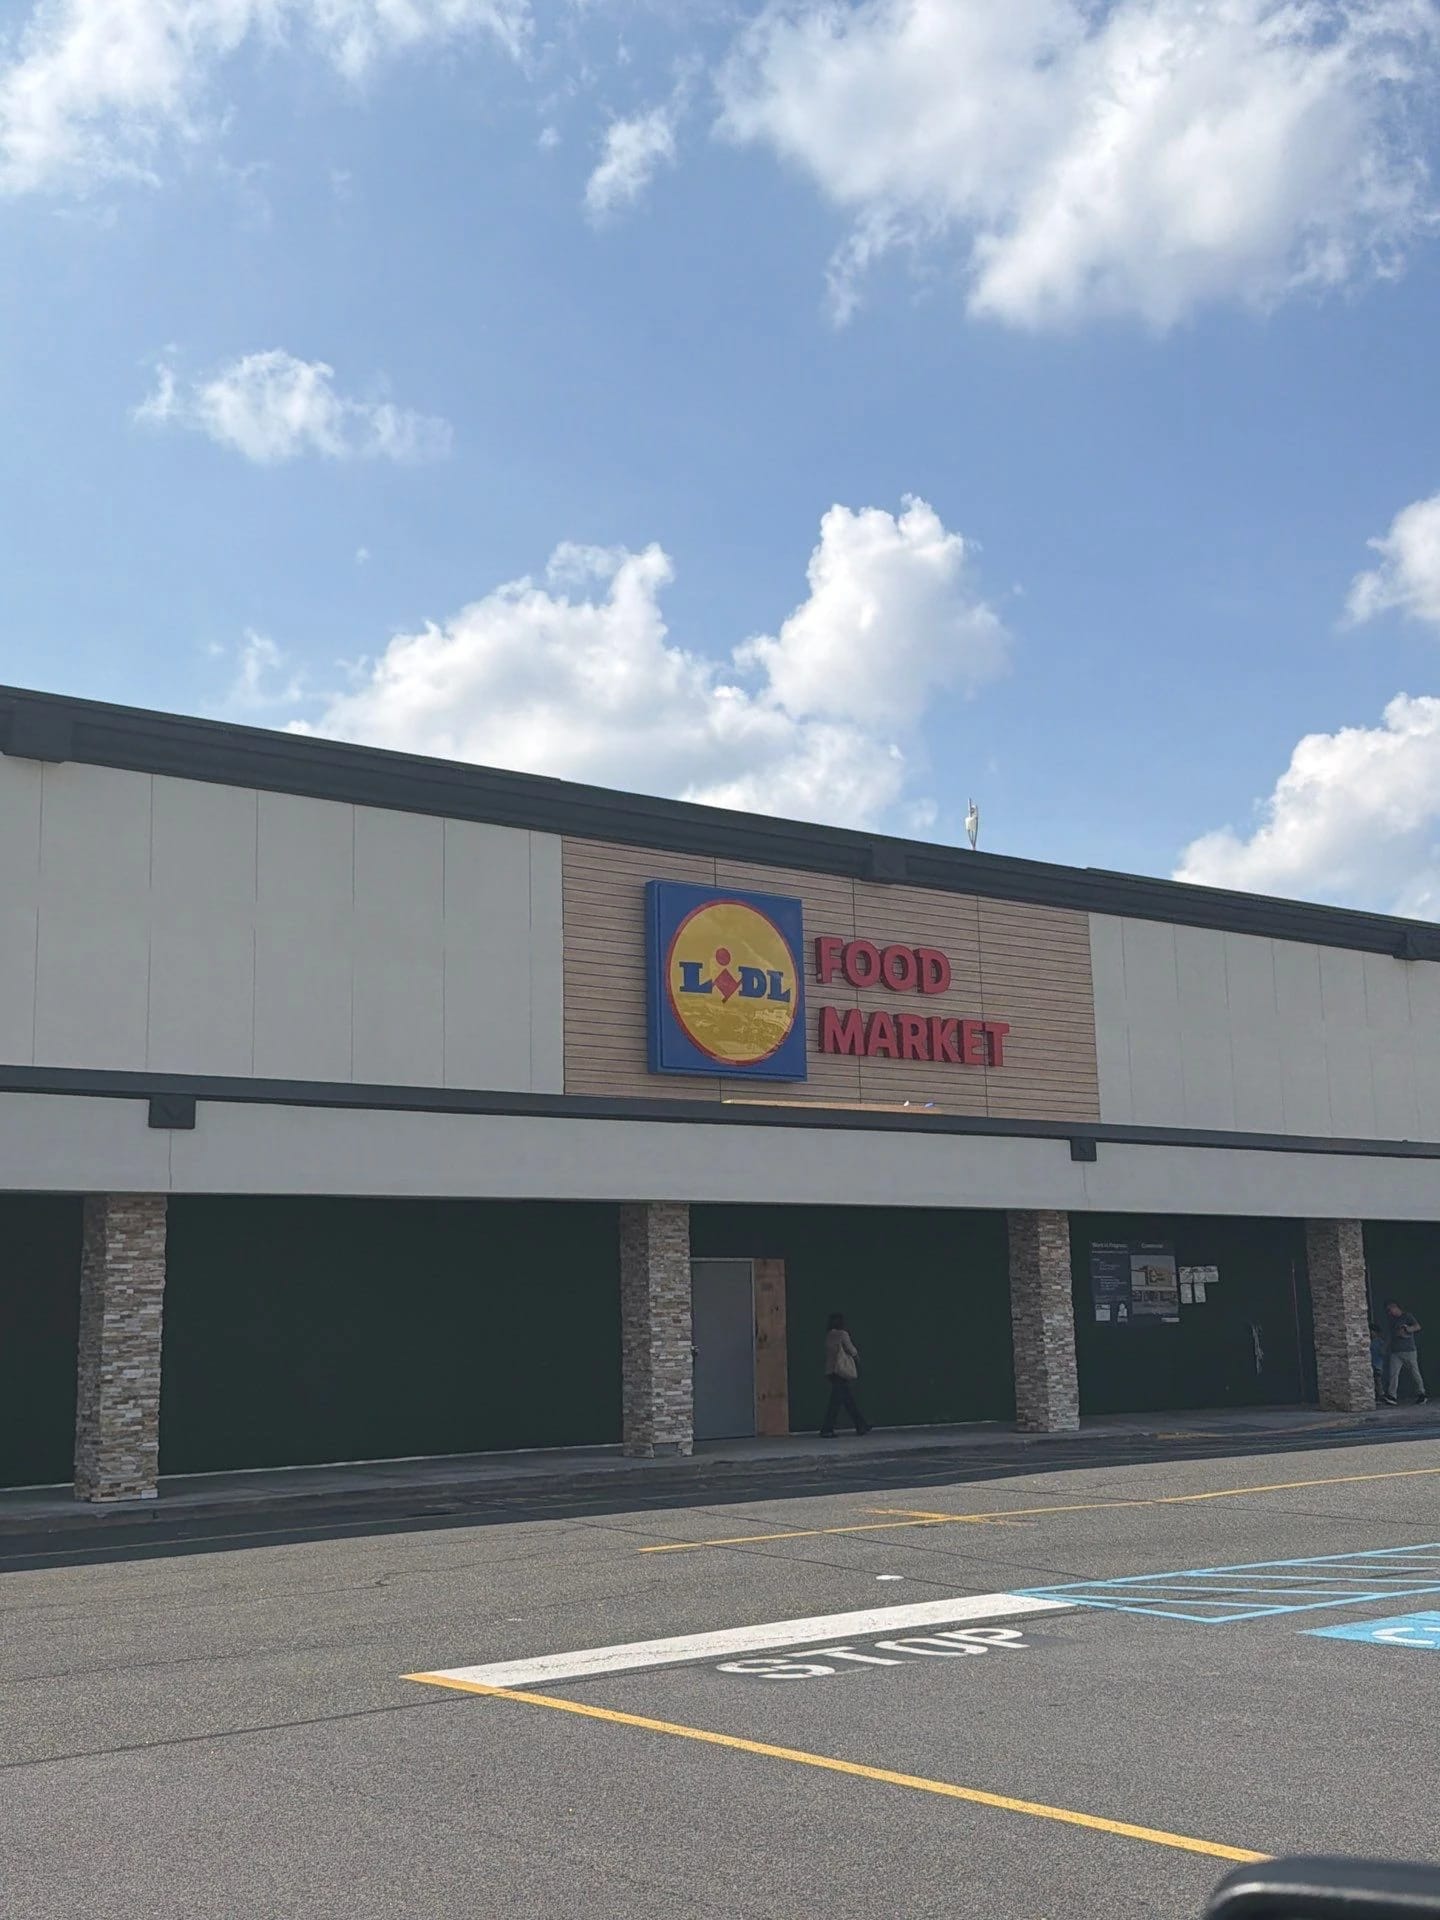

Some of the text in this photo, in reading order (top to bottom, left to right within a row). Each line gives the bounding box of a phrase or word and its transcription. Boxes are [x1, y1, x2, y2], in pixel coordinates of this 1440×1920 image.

[815, 936, 950, 994] FOOD
[818, 1005, 1010, 1066] MARKET
[716, 1627, 1031, 1679] STOP
